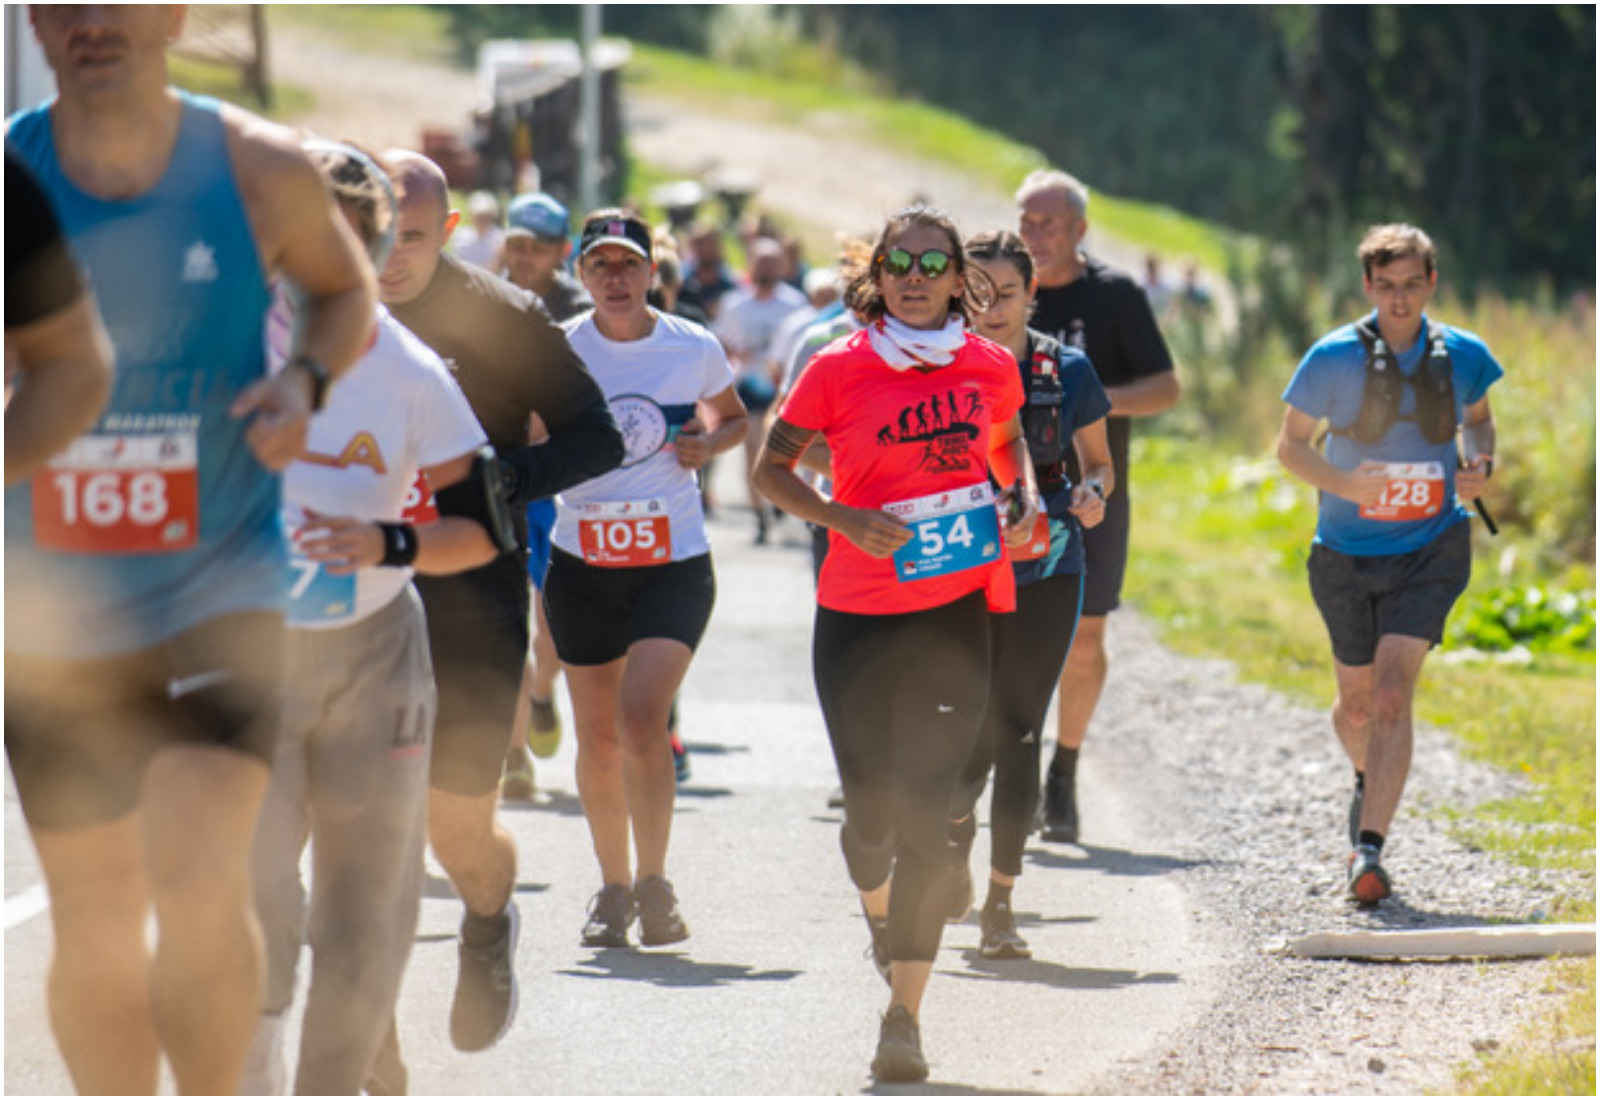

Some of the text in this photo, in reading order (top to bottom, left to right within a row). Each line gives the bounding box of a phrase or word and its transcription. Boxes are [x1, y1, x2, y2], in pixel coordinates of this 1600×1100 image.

[54, 473, 169, 526] 168
[1380, 481, 1429, 506] 128
[591, 520, 656, 551] 105
[918, 514, 974, 555] 54
[290, 560, 320, 598] 7
[390, 703, 427, 748] LA
